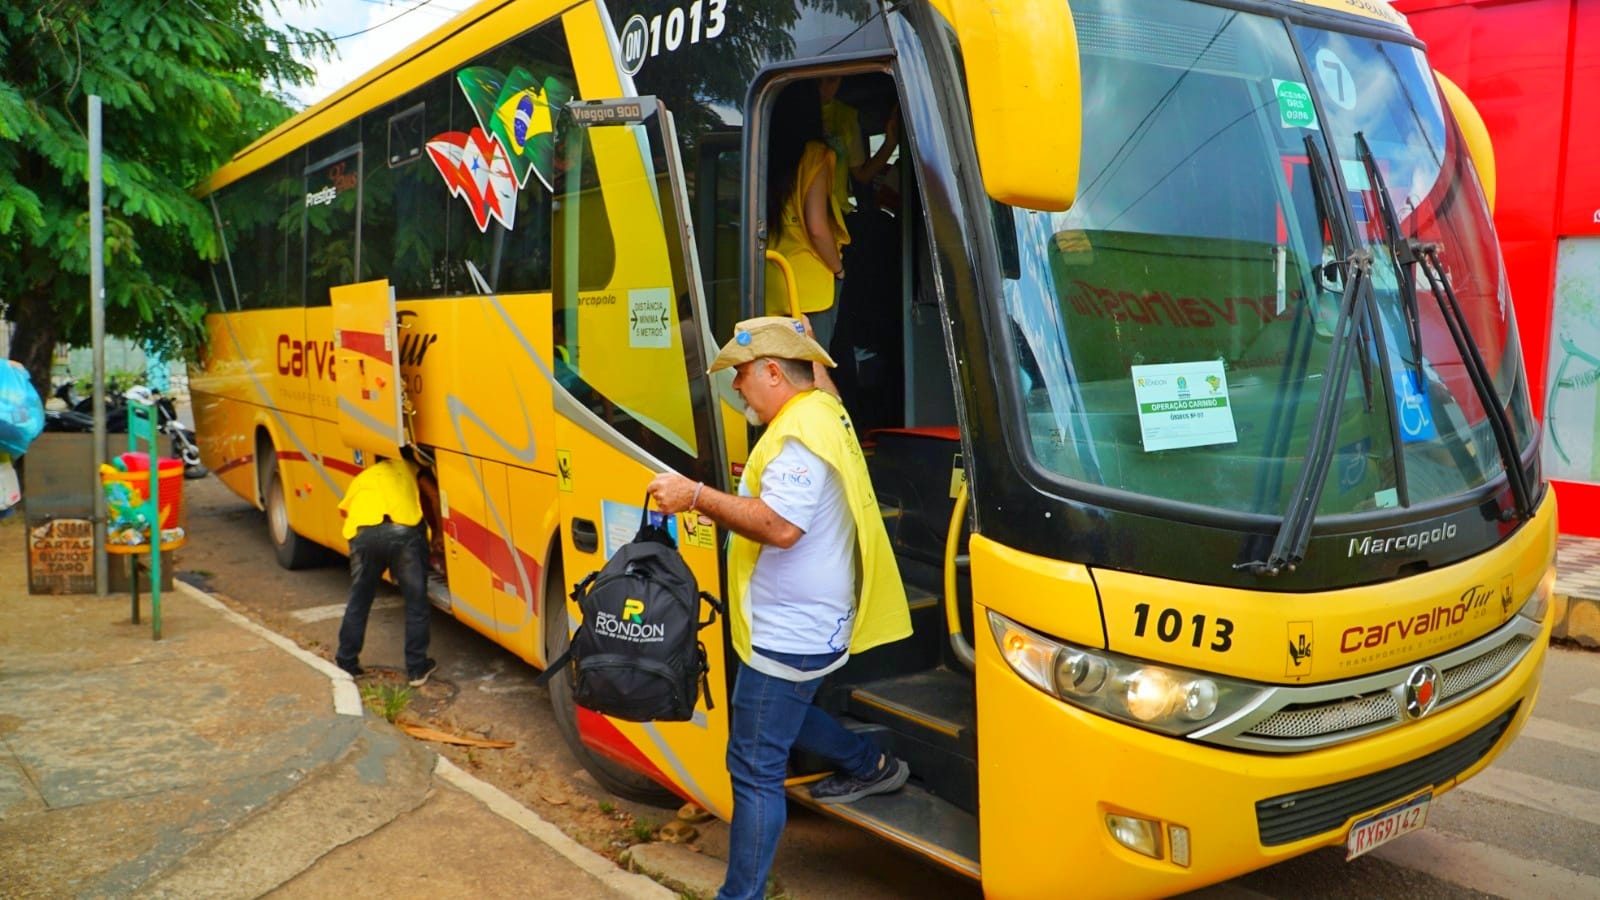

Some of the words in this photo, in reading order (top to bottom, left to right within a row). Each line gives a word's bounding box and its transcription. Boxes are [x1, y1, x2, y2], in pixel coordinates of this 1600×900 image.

[650, 0, 727, 57] 1013
[1322, 60, 1345, 102] 7
[572, 106, 614, 121] Viaggio
[616, 104, 640, 118] 900
[305, 186, 337, 208] Prestige
[578, 294, 617, 308] arcopolo
[1151, 400, 1188, 412] OPERAÇÃO
[34, 540, 92, 550] CARTAS
[1347, 522, 1457, 557] Marcopolo
[595, 615, 665, 638] RONDON
[1133, 603, 1234, 653] 1013
[1339, 602, 1466, 654] Carvalho
[1460, 584, 1495, 612] Tur
